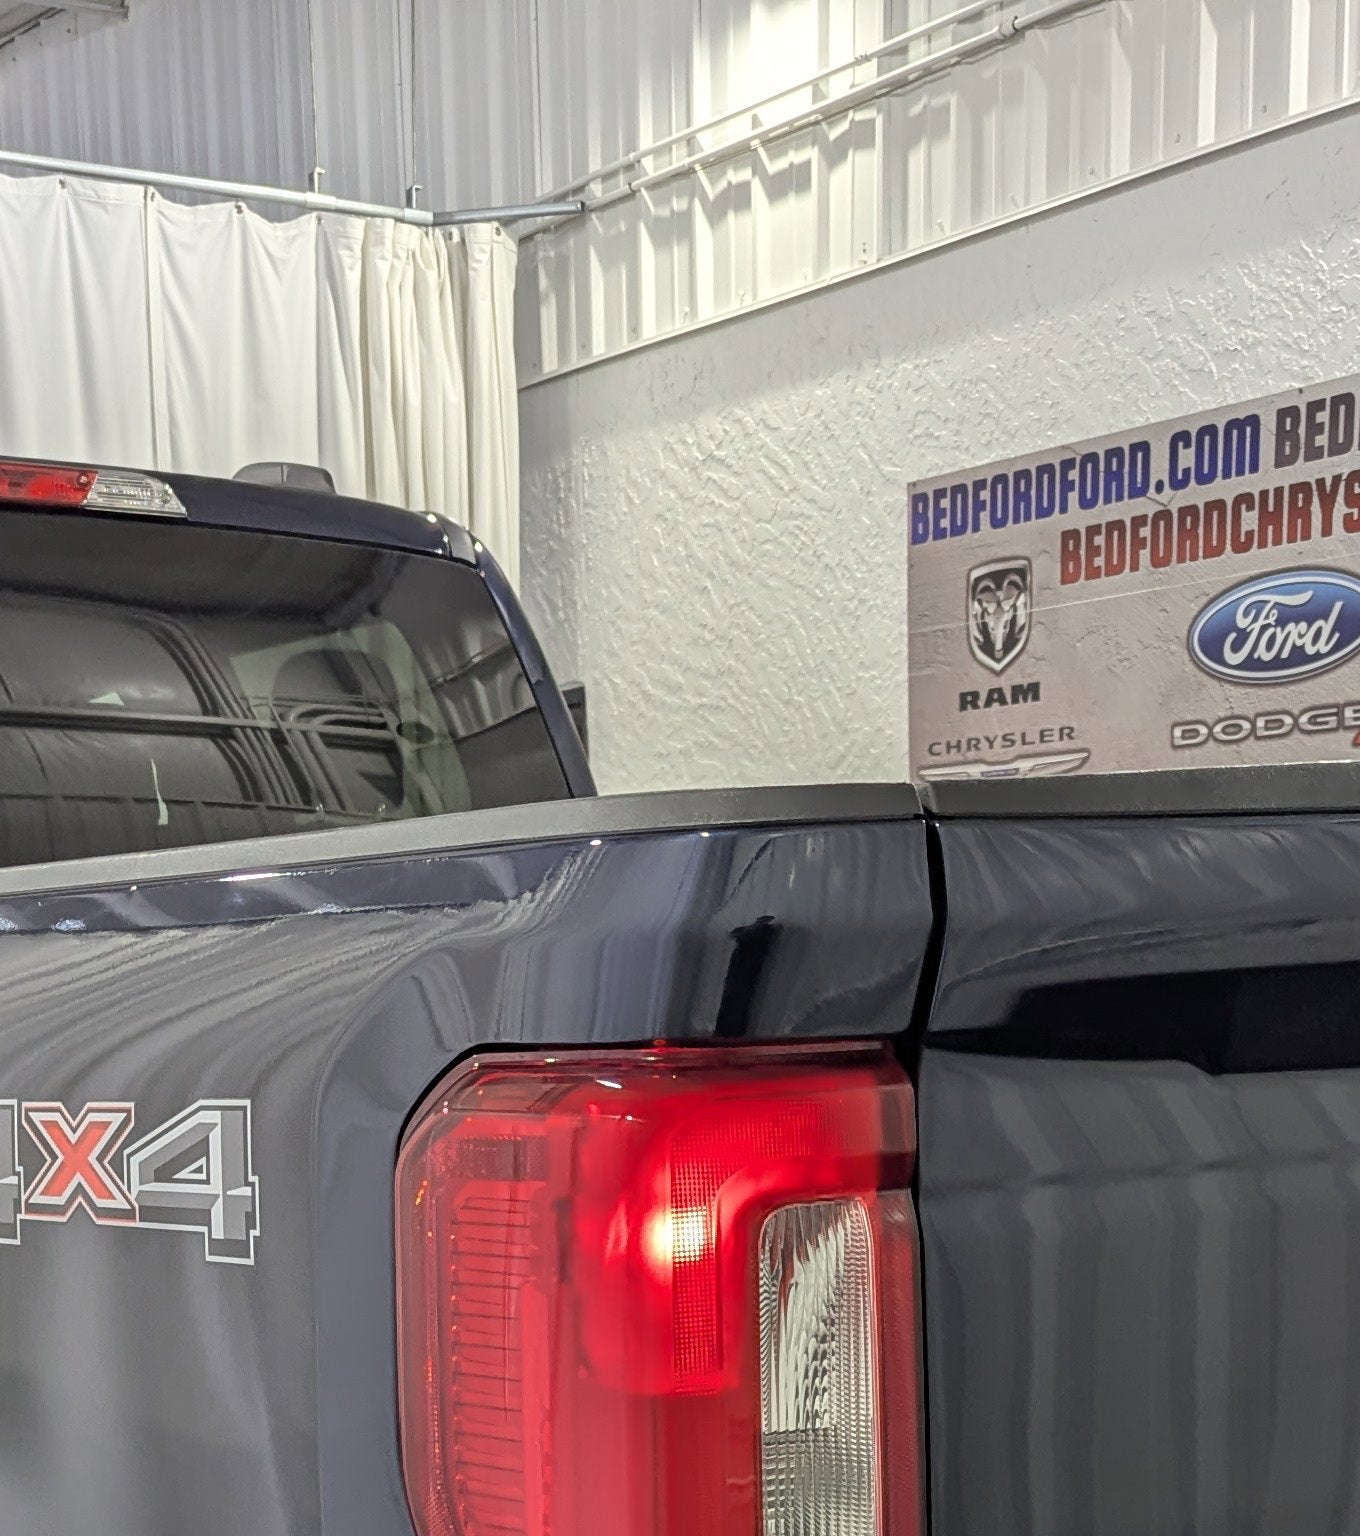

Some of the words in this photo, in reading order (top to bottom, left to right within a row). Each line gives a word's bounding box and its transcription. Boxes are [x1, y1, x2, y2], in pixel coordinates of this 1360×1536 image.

[911, 413, 1261, 546] BEDFORDFORD.COM
[1223, 590, 1344, 666] Ford
[958, 681, 1041, 712] RAM
[927, 726, 1076, 757] CHRYSLER
